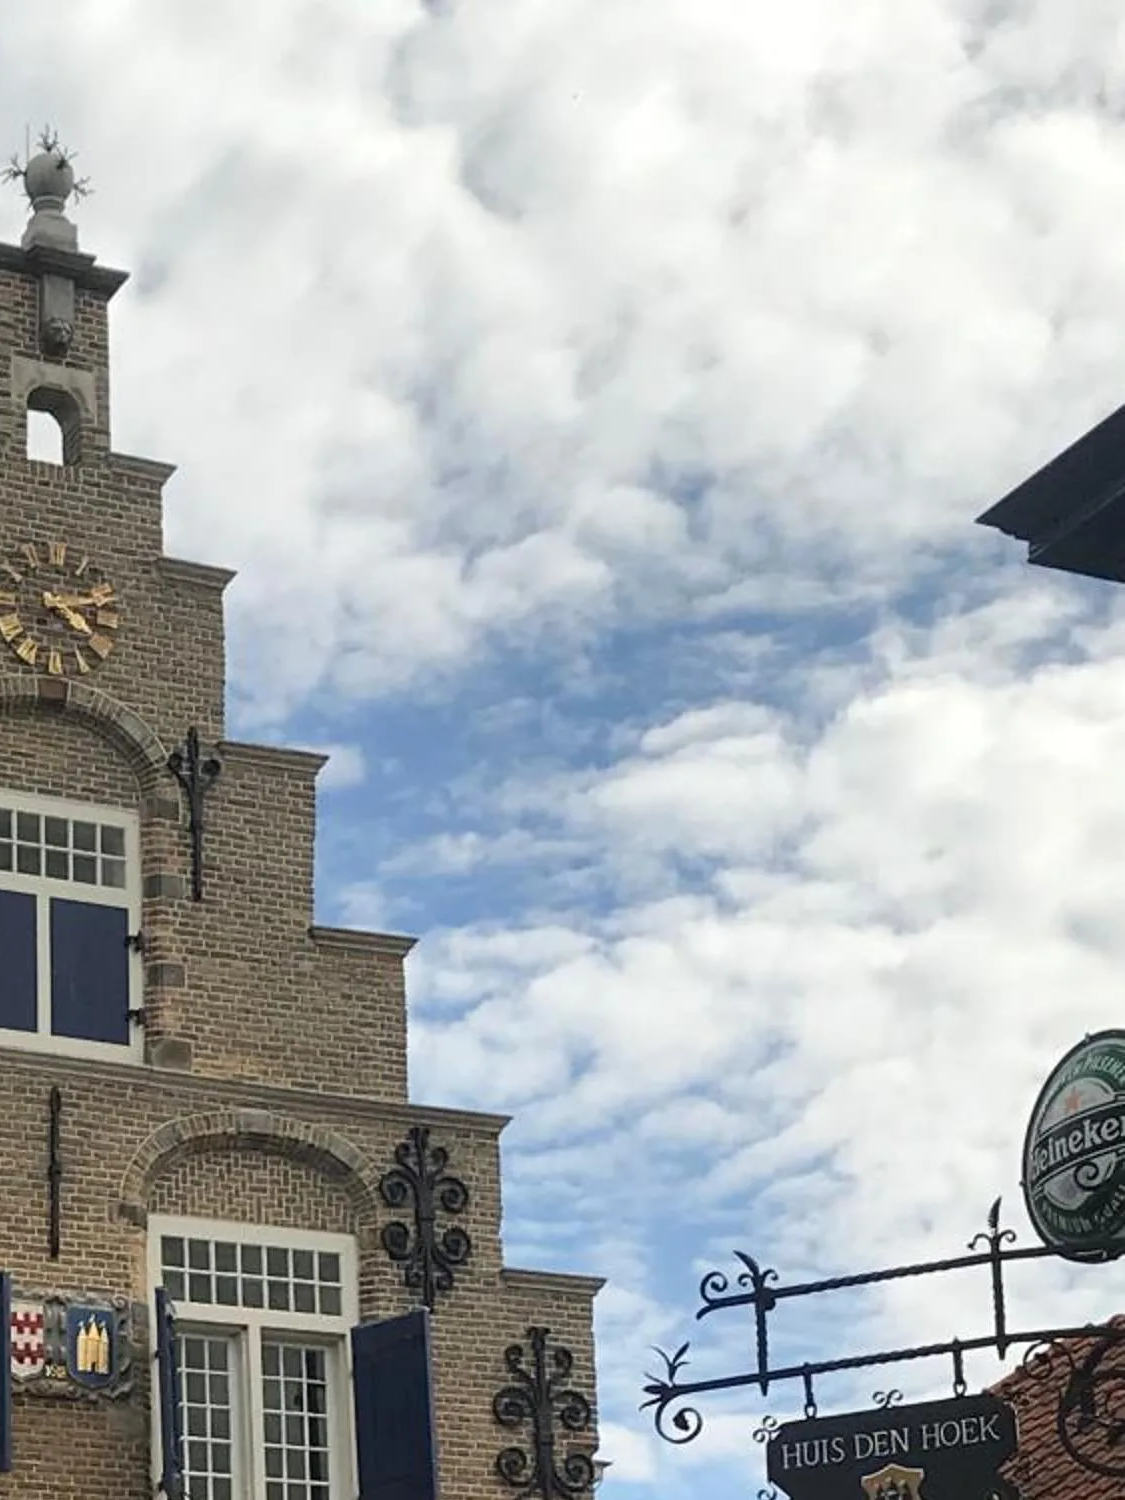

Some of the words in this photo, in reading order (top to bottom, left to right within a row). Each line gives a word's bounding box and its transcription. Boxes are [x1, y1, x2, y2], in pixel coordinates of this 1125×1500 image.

[782, 1436, 845, 1470] HUIS
[854, 1427, 909, 1460] DEN
[921, 1413, 1000, 1450] HOEK
